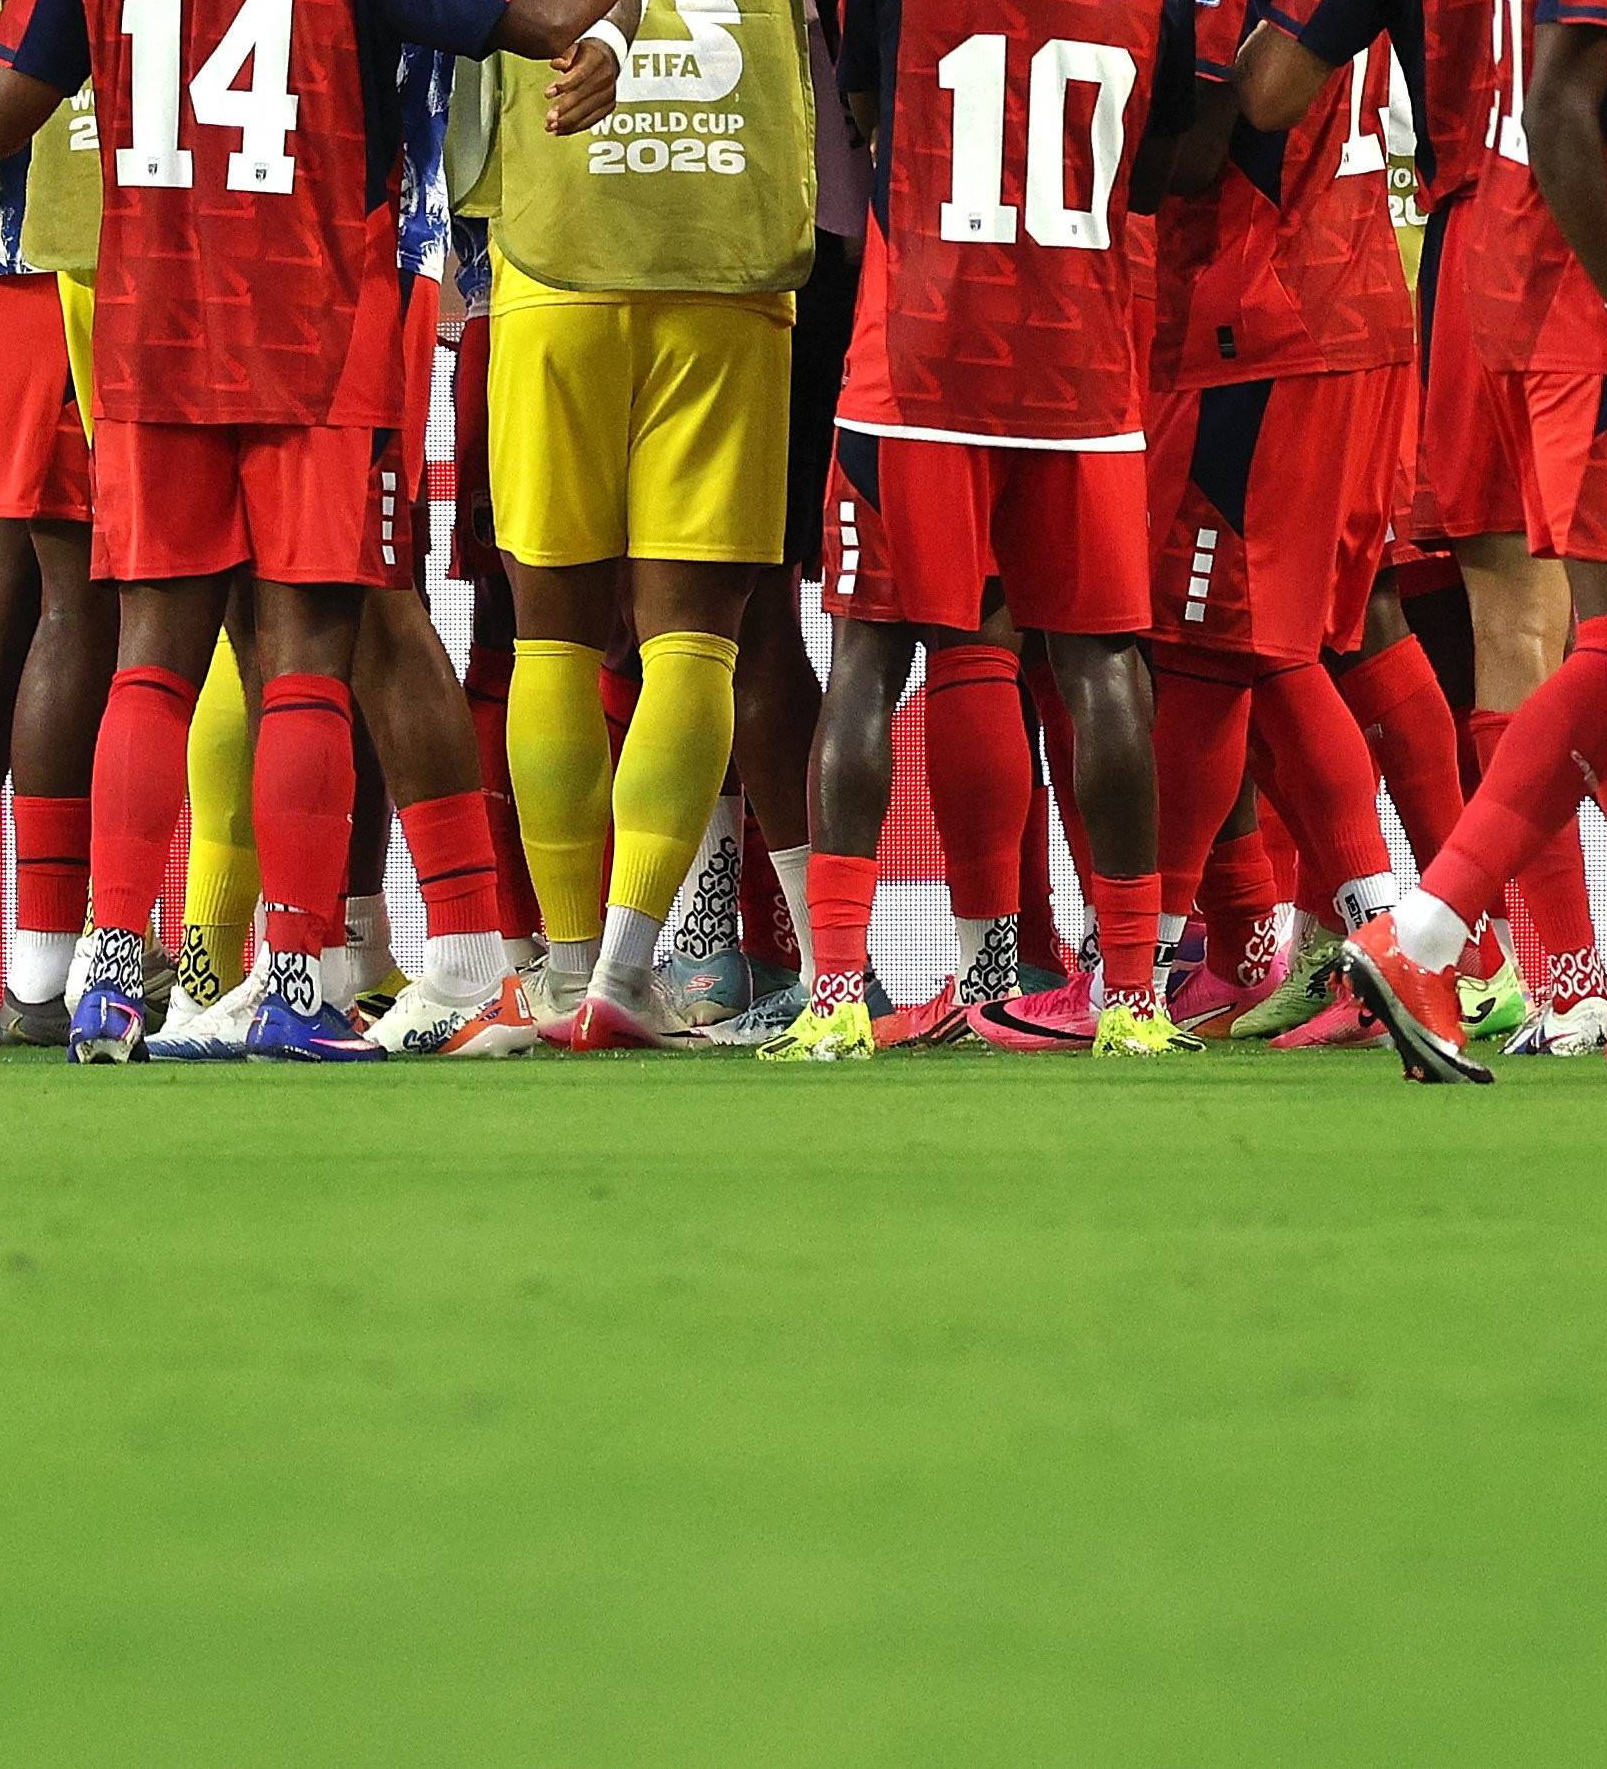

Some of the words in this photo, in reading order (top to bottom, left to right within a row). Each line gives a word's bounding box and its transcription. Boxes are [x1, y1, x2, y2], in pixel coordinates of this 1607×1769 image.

[633, 53, 701, 79] FIFA
[588, 112, 687, 134] WORLD
[692, 113, 744, 133] CUP
[588, 138, 745, 174] 2026
[938, 34, 1137, 250] 10
